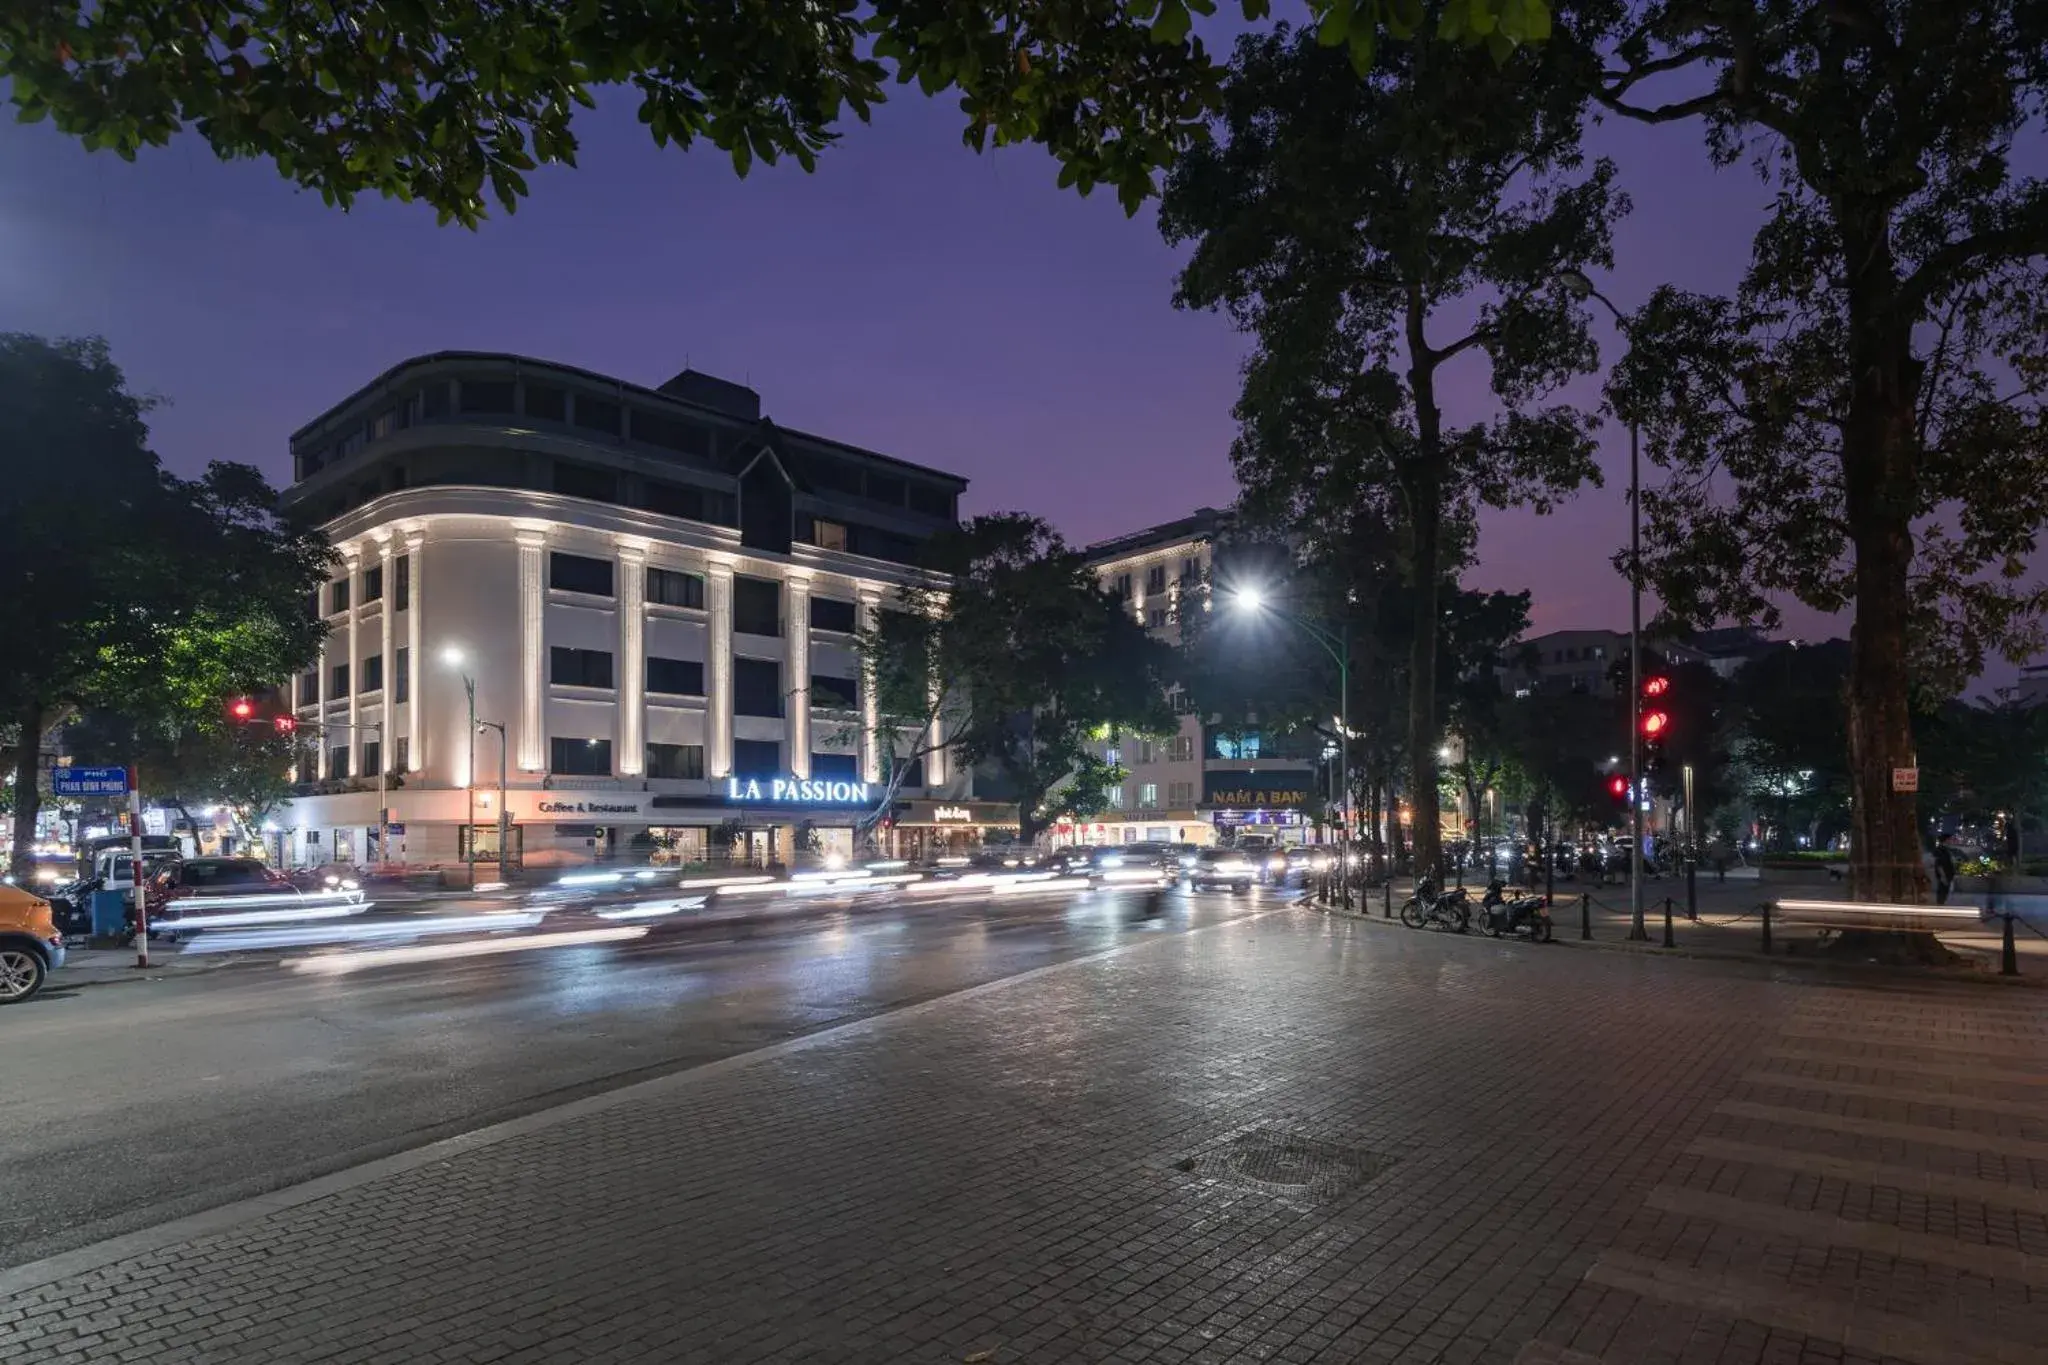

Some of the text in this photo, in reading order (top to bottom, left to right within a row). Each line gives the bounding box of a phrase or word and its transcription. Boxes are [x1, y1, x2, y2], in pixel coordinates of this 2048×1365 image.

[729, 777, 867, 801] LA PASSION
[538, 802, 574, 812] Coffee
[588, 802, 637, 812] Restaurant
